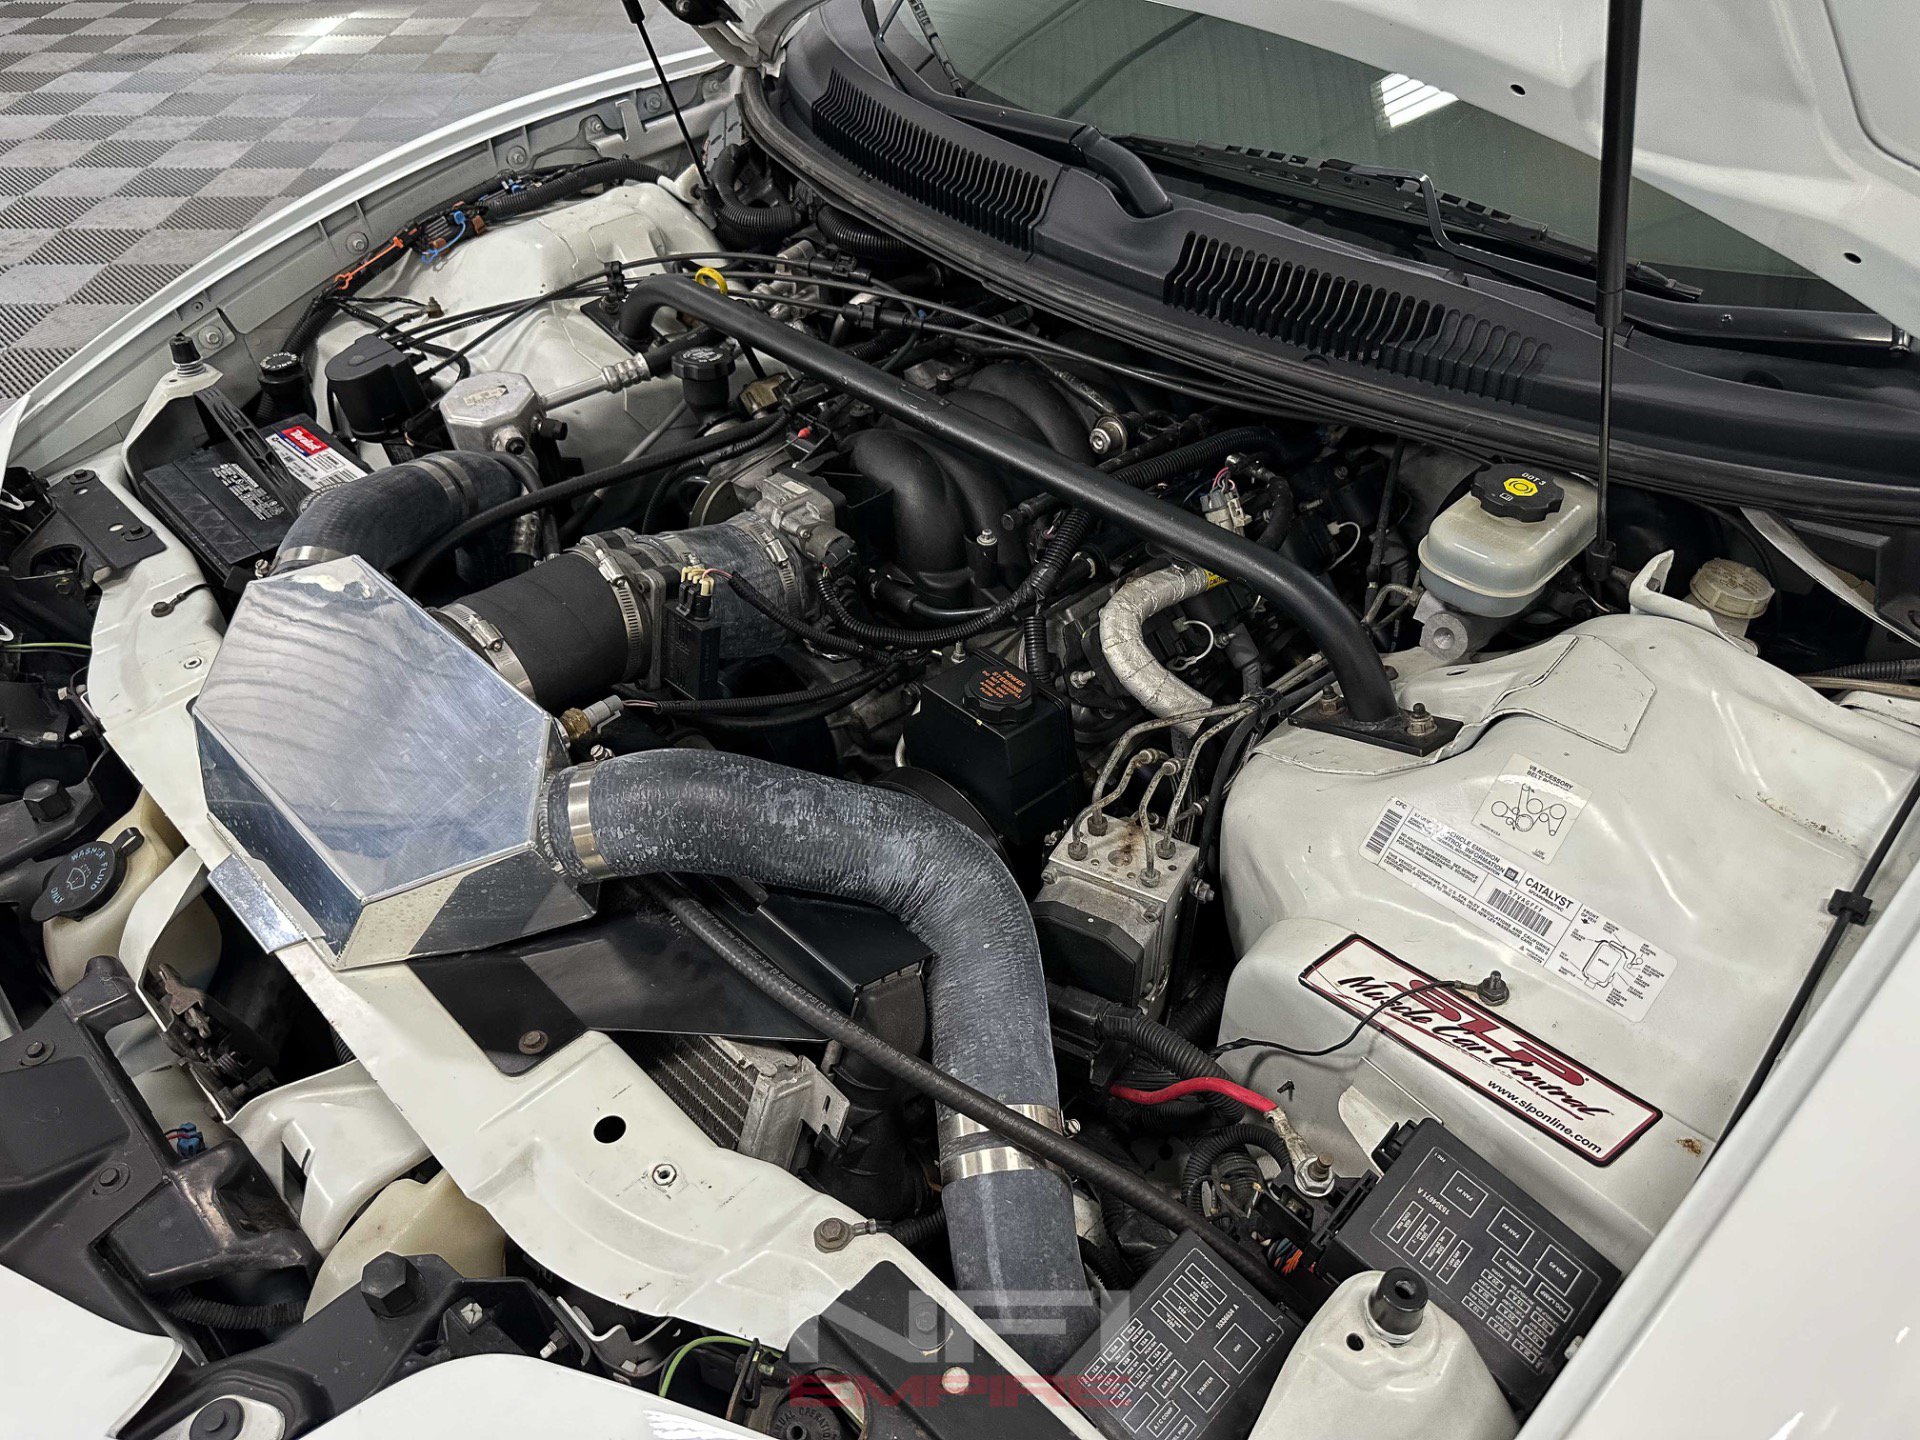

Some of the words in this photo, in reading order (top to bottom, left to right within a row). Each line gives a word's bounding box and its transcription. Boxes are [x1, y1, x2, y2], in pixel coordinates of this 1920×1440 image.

[1521, 472, 1539, 482] DOT
[991, 670, 1022, 694] STEERING
[1002, 669, 1025, 688] POWER
[1526, 770, 1541, 780] BELT
[1537, 768, 1573, 789] ACCESSORY
[1394, 799, 1407, 809] CFC
[71, 847, 105, 861] WASHER
[1463, 846, 1505, 873] INFORMATION
[1471, 843, 1500, 863] EMISSION
[90, 861, 107, 889] FLUID
[50, 887, 64, 903] ONLY
[1524, 876, 1573, 909] CATALYST
[1385, 978, 1583, 1088] SLP
[1336, 972, 1430, 1026] Muscle
[1431, 1021, 1493, 1060] Car
[1489, 1054, 1609, 1118] Central
[804, 991, 820, 1006] PSI
[847, 1021, 864, 1035] SAE
[863, 1031, 885, 1049] 30R7
[884, 1044, 899, 1057] Not
[898, 1053, 914, 1066] For
[912, 1061, 932, 1077] Fuel
[996, 1110, 1019, 1128] Made
[1486, 1078, 1603, 1154] www.slponline.com
[1460, 1189, 1473, 1202] FAN
[1507, 1227, 1520, 1239] FAN
[1490, 1267, 1504, 1279] HORN
[1505, 1260, 1521, 1275] HORN
[1554, 1266, 1567, 1278] FAN
[1539, 1289, 1555, 1304] LAMP
[1513, 1307, 1525, 1318] FUEL
[1554, 1301, 1567, 1314] FOG
[1160, 1379, 1169, 1389] AIR
[1166, 1368, 1178, 1381] PUMP
[1196, 1375, 1214, 1395] STARTER
[1161, 1406, 1173, 1420] COMP
[1177, 1421, 1189, 1435] PUMP
